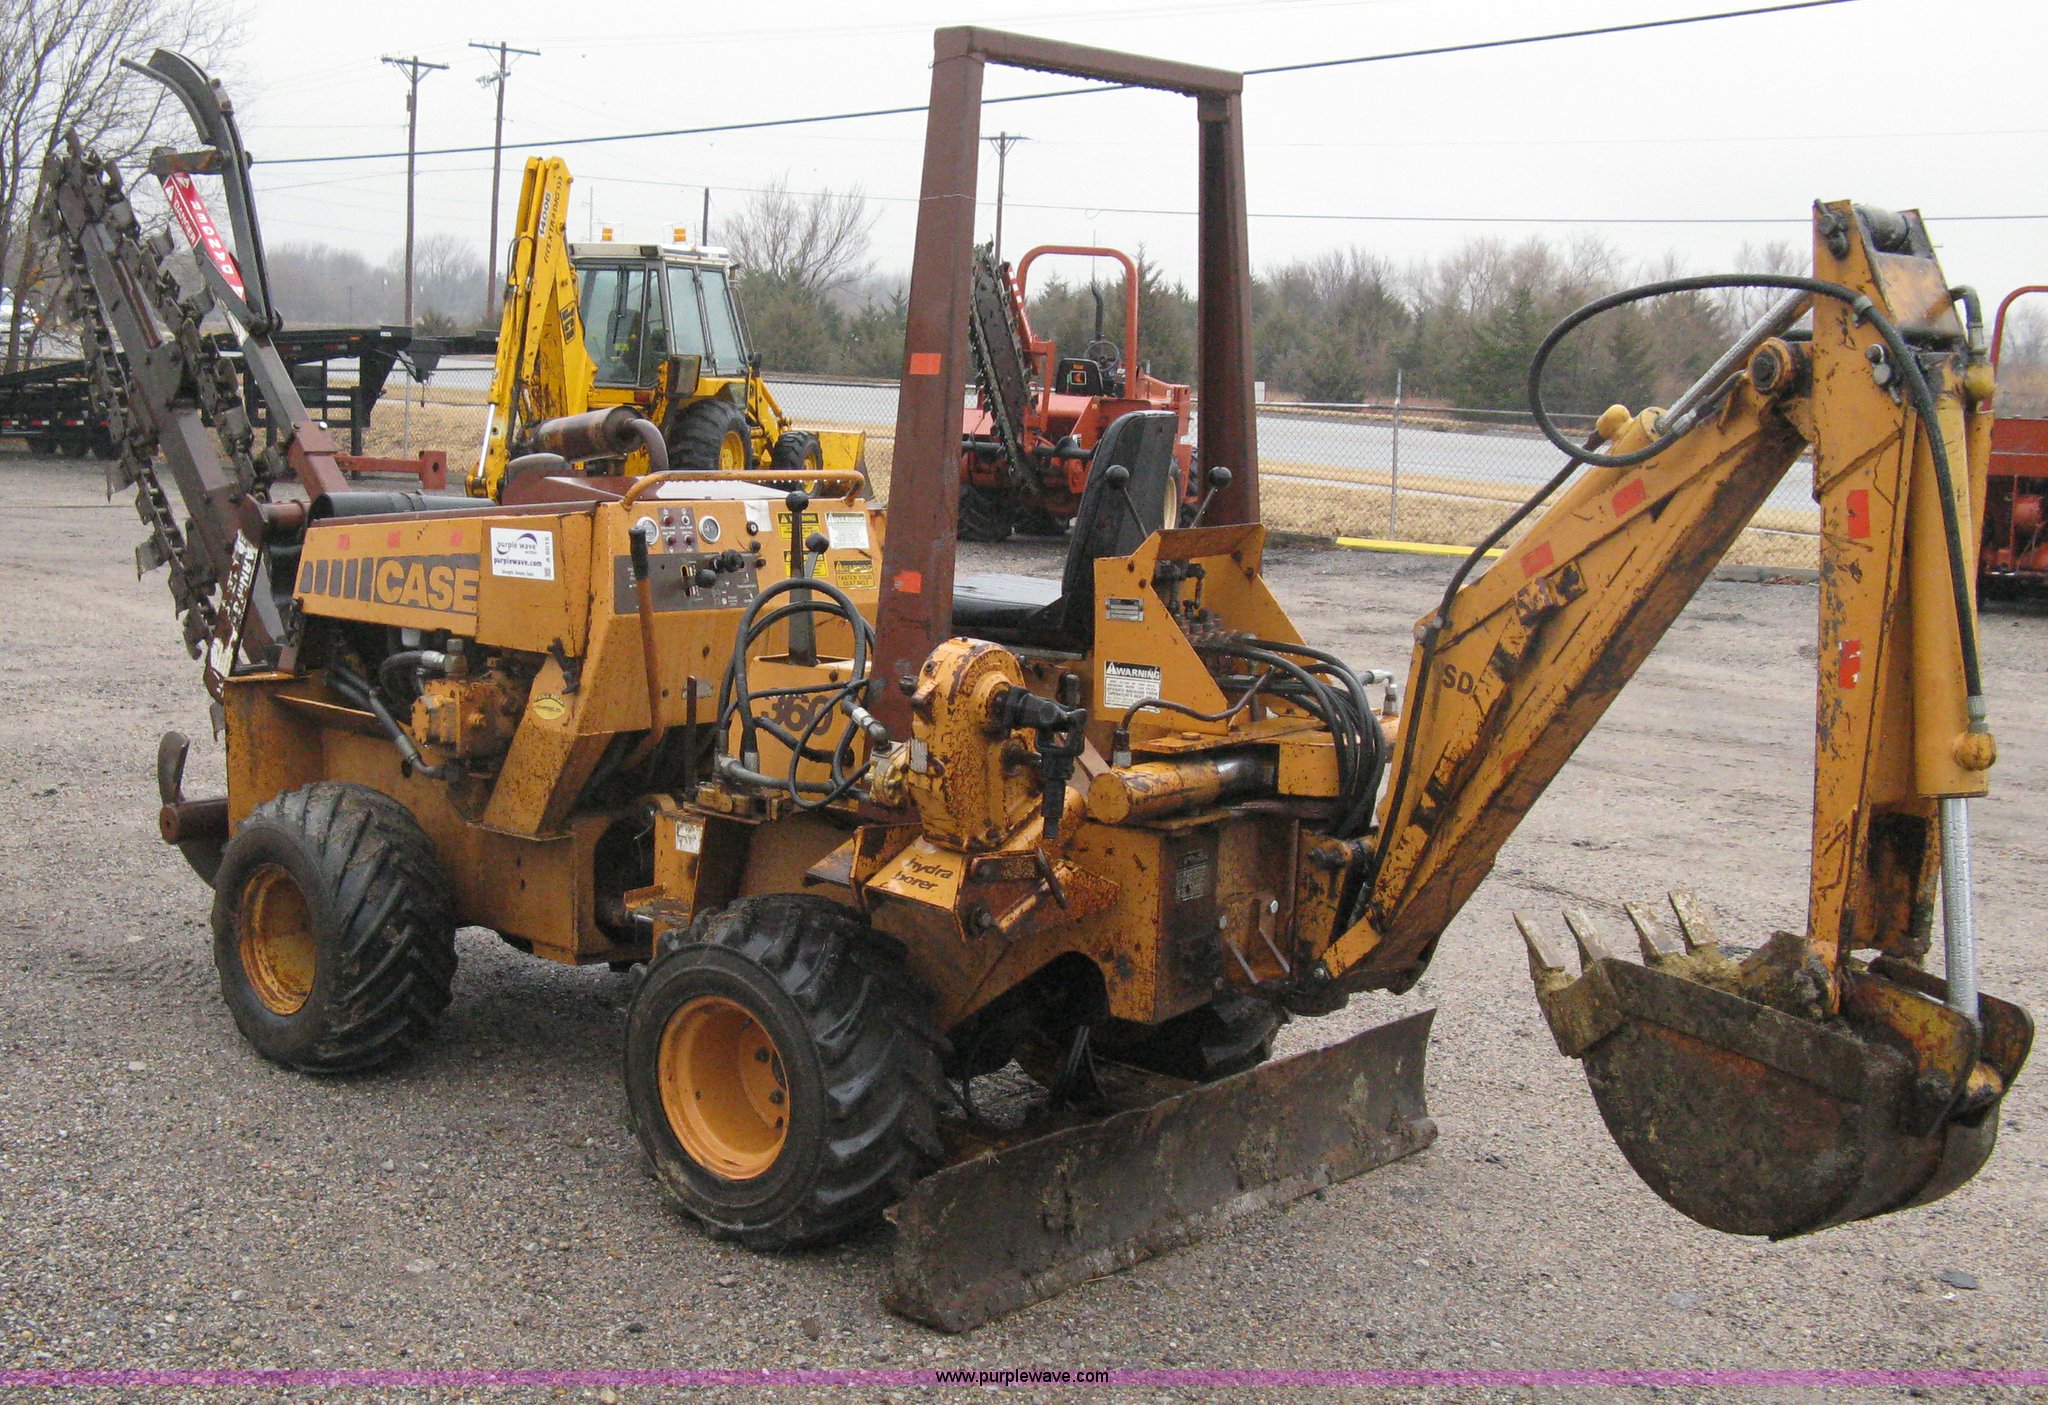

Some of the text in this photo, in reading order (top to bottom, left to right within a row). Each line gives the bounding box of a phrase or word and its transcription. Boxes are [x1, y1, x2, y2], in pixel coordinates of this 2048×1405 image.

[173, 200, 196, 243] DANGER
[190, 200, 234, 275] DANGER
[497, 541, 518, 550] purple
[494, 557, 542, 567] purplewave.com
[376, 560, 480, 612] CASE
[1116, 667, 1160, 680] WARNING
[761, 694, 834, 736] 360
[905, 857, 954, 879] hydra
[892, 870, 938, 890] borer
